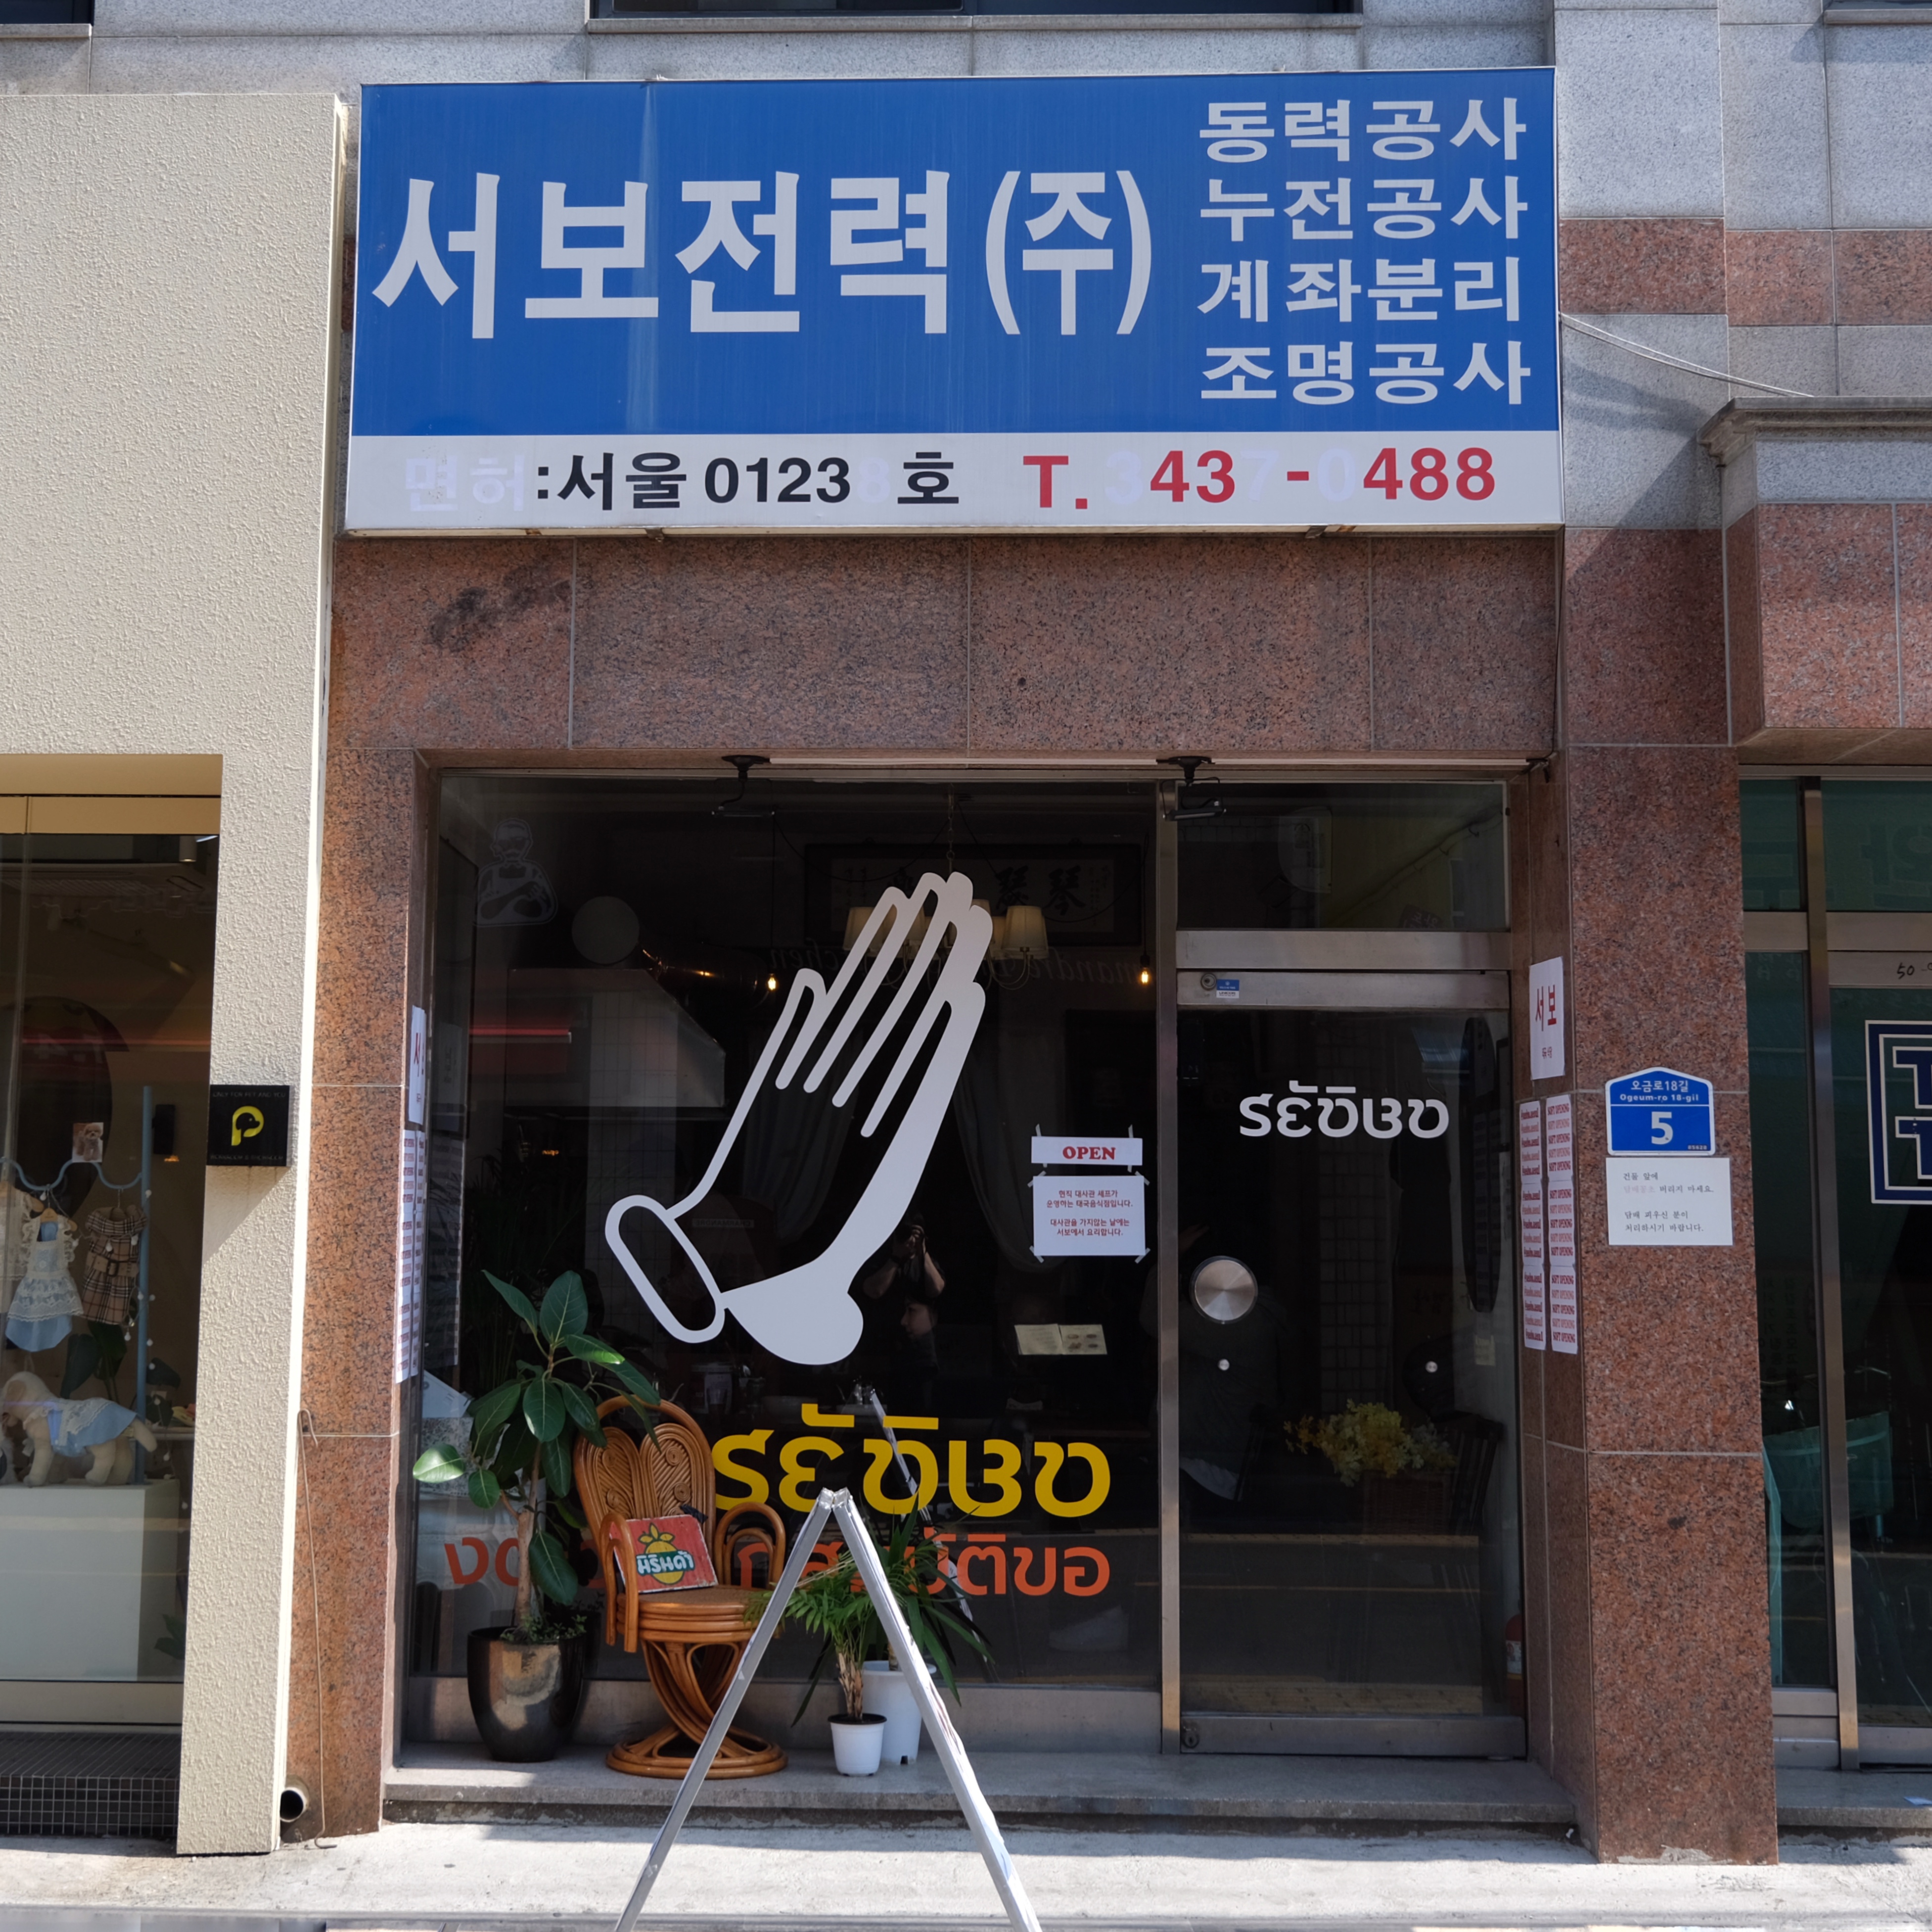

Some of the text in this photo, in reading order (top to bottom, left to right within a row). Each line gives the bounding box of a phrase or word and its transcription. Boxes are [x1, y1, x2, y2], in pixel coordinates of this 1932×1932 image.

[1200, 97, 1526, 163] 동력공사
[1200, 176, 1528, 241] 누전공사
[1197, 256, 1519, 322] 계좌분리
[1201, 340, 1531, 405] 조명공사
[897, 452, 959, 504] 호
[1535, 985, 1557, 1032] 서보
[1620, 1094, 1699, 1103] Ogeum-ro 18-gil
[1631, 1081, 1689, 1092] 오금로18길
[1651, 1111, 1673, 1145] 5
[1062, 1146, 1115, 1160] OPEN
[1076, 1199, 1133, 1208] 태국음식점입니다.
[1659, 1185, 1683, 1193] 버리지
[1688, 1185, 1714, 1193] 마세요.
[1087, 1228, 1124, 1236] 요리합니다.
